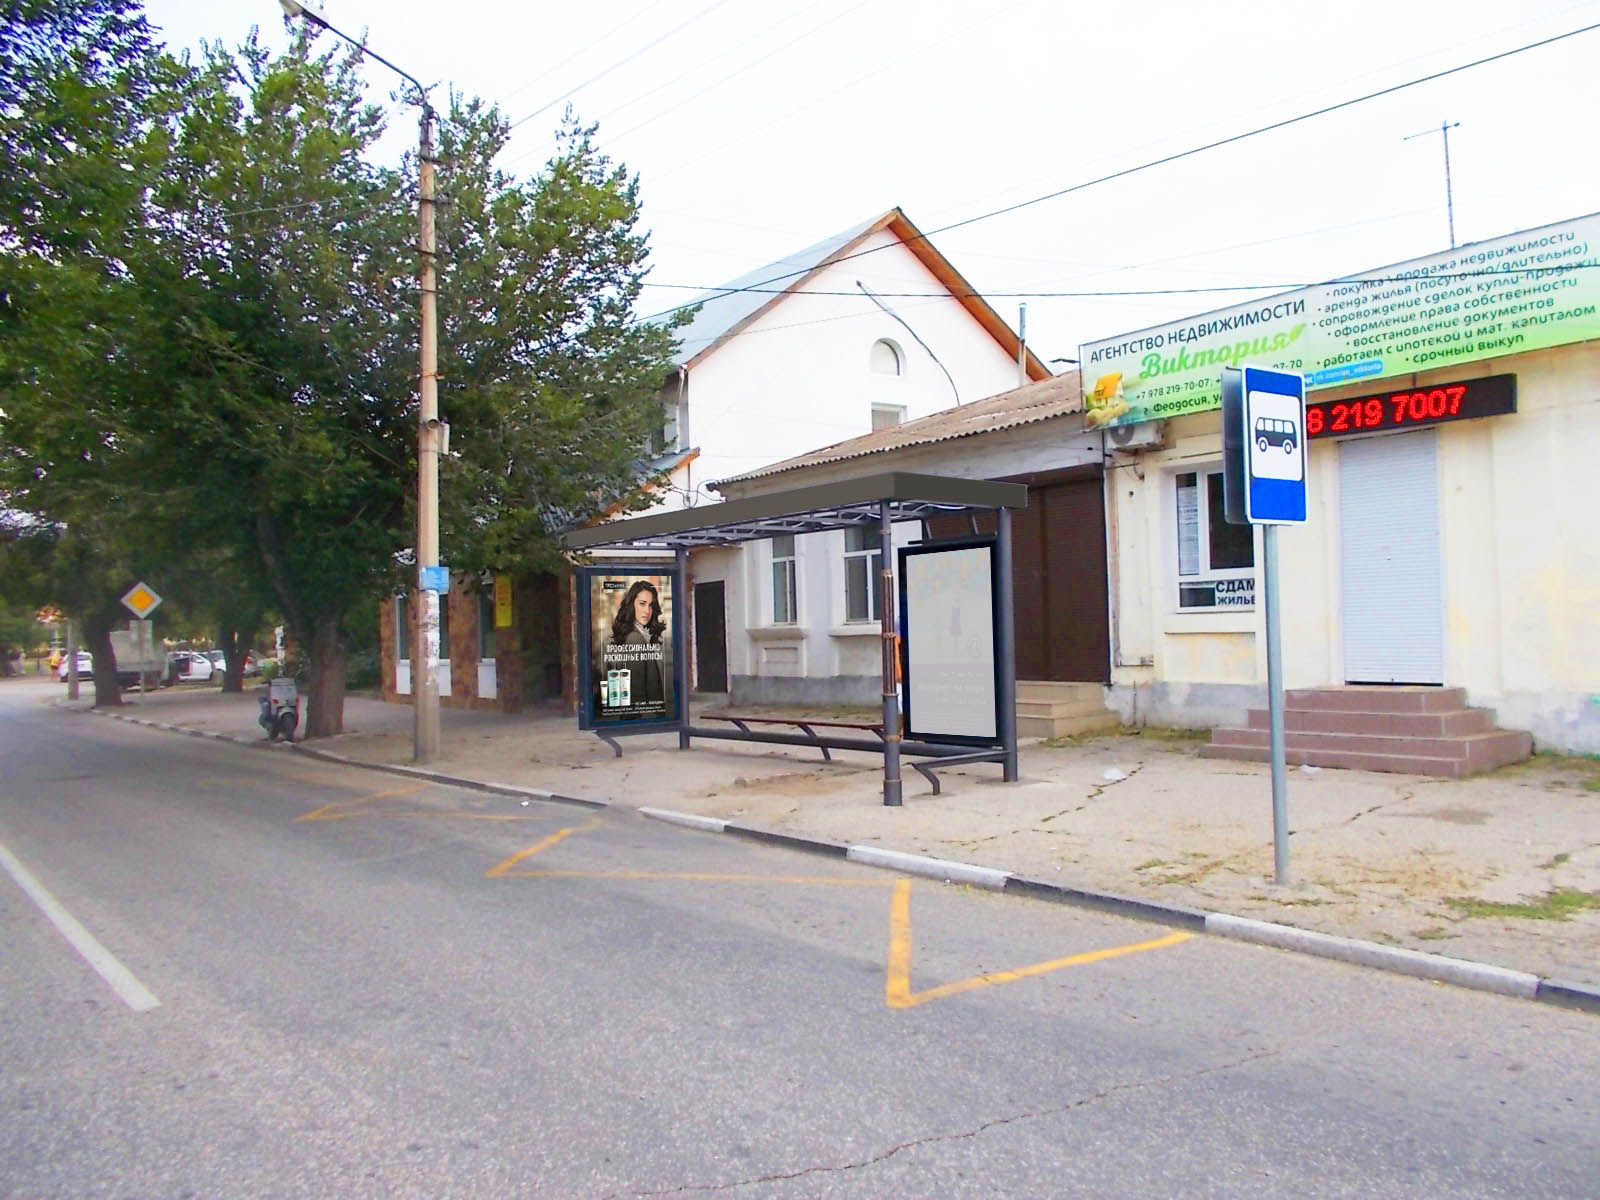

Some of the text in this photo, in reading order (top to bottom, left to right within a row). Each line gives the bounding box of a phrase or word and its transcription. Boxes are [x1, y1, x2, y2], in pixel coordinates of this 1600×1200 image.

[1332, 276, 1384, 297] покупка
[1396, 259, 1457, 281] продажа
[1460, 232, 1575, 266] недвижимости
[1319, 258, 1598, 328] сопровождение сделок купли-продажи
[1324, 296, 1368, 313] аренда
[1370, 285, 1412, 303] жилья
[1334, 277, 1578, 339] оформление права собственности
[1090, 299, 1305, 363] АГЕНТСТВО НЕДВИЖИМОСТИ
[1323, 304, 1596, 368] работаем с ипотекой и мат. капиталом
[1353, 297, 1555, 348] восстановление документов
[1139, 330, 1291, 379] Виктория
[1412, 334, 1524, 365] срочный выкуп
[1136, 391, 1146, 400] +7
[1148, 387, 1164, 398] 978
[1153, 396, 1211, 413] Феодосия,
[1330, 398, 1383, 431] 219
[1391, 386, 1467, 423] 7007
[604, 652, 663, 662] РОСКОШНЫЕ ВОЛОСЫ
[606, 643, 661, 653] ПРОФЕССИОНАЛЬНО
